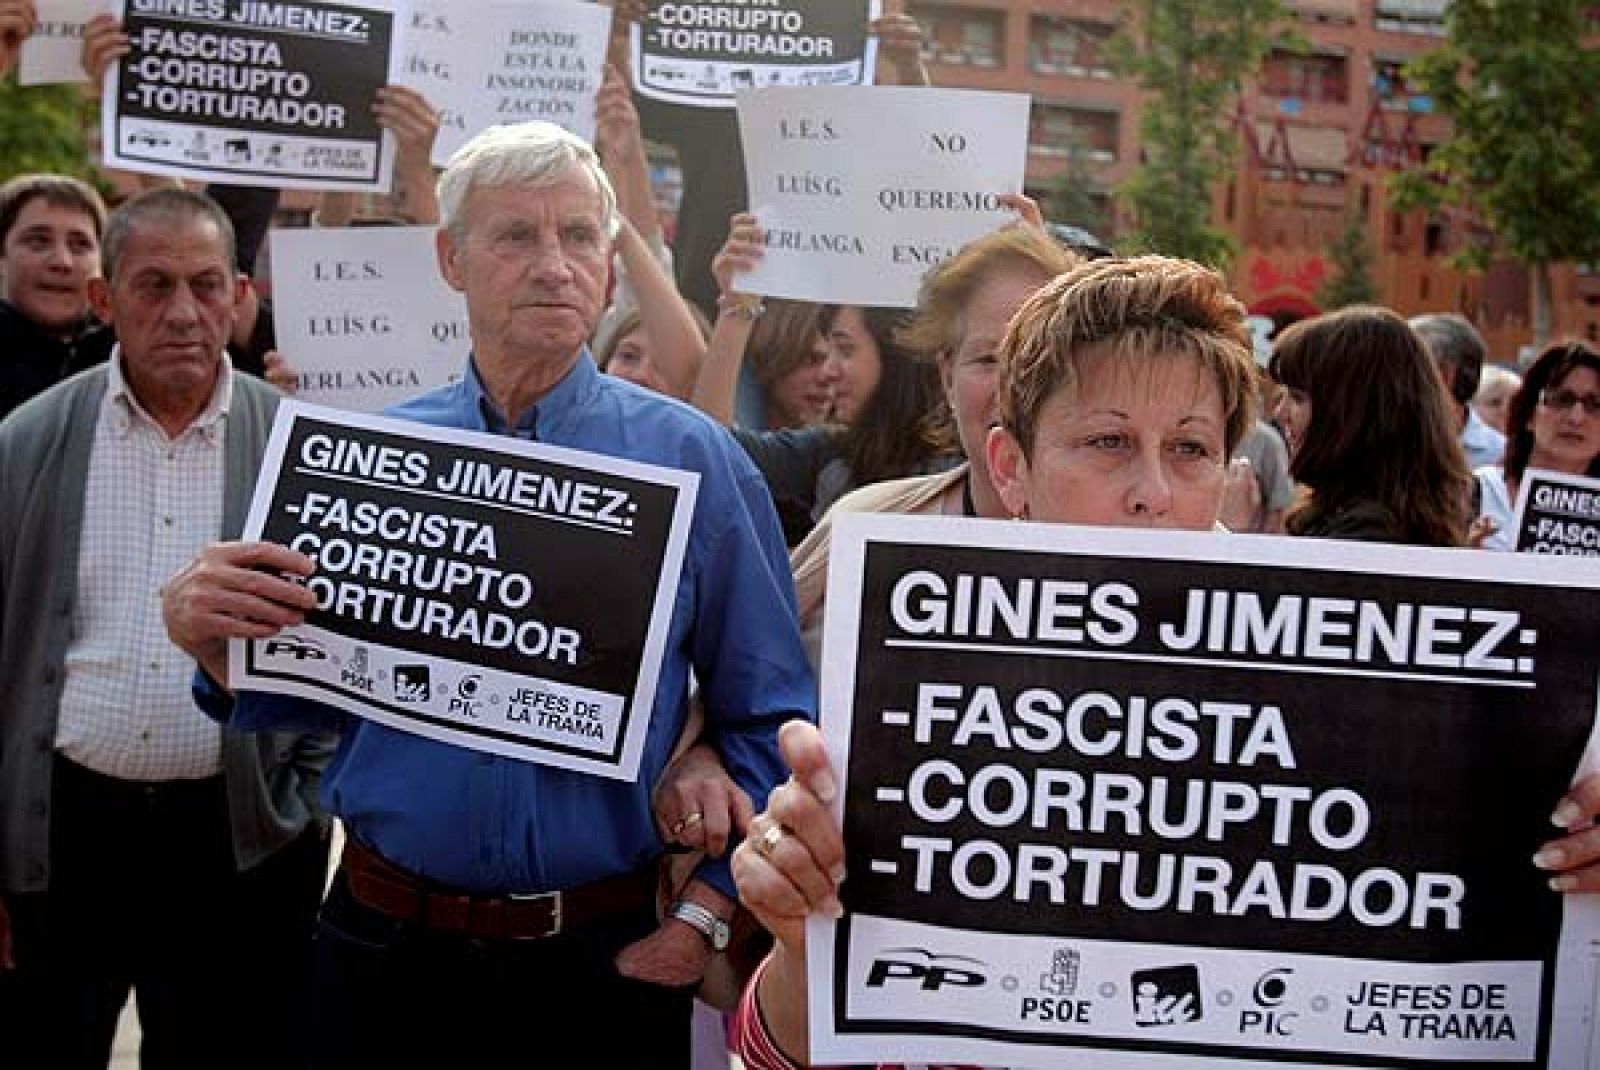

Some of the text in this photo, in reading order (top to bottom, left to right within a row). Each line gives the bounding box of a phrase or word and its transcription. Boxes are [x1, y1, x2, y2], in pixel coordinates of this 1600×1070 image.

[232, 0, 370, 38] JIMENEZ:
[648, 3, 804, 33] -CORRUPTO
[130, 25, 282, 67] -FASCISTA
[648, 27, 834, 57] -TORTURADOR
[128, 55, 310, 97] -CORRUPTO
[127, 82, 346, 128] -TORTURADOR
[931, 132, 967, 153] NO
[878, 189, 1013, 213] QUEREMO
[764, 229, 864, 254] ERLANGA
[300, 369, 420, 391] ERLANGA
[301, 434, 638, 527] GINES JIMENEZ:
[285, 492, 497, 560] -FASCISTA
[290, 575, 582, 666] ORTURADOR
[890, 569, 1537, 674] GINES JIMENEZ:
[509, 688, 601, 720] JEFES DE
[507, 704, 604, 740] LA TRAMA
[882, 682, 1298, 770] -FASCISTA
[876, 759, 1371, 851] -CORRUPTO
[871, 836, 1466, 931] -TORTURADOR
[866, 958, 987, 990] PP
[1021, 997, 1092, 1023] PSOE
[1346, 981, 1507, 1010] JEFES DE
[1239, 1010, 1300, 1036] PIC
[1344, 1009, 1516, 1042] LA TRAMA
